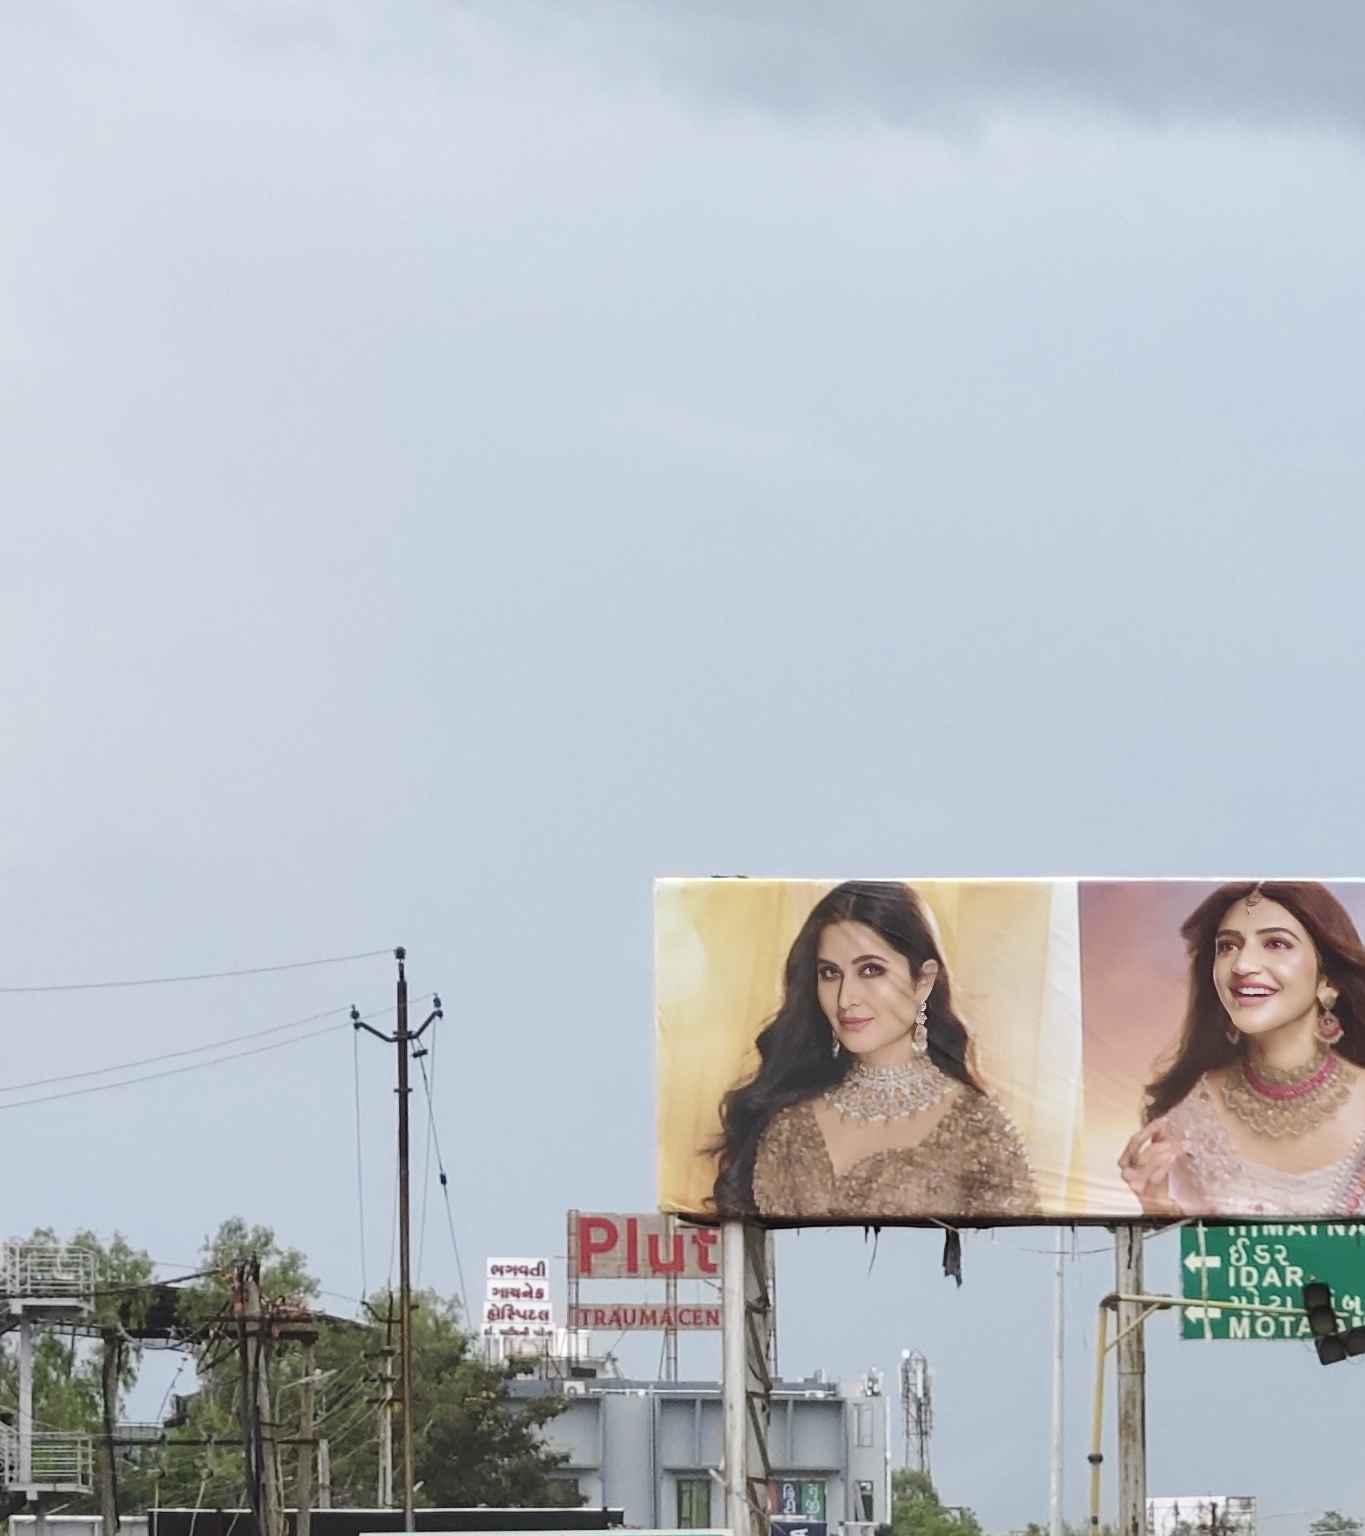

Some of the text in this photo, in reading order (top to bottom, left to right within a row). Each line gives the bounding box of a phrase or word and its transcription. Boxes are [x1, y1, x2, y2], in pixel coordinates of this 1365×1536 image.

[1229, 1238, 1290, 1266] ઈડર
[490, 1260, 546, 1277] ભગવતી
[1228, 1266, 1304, 1287] IDAR
[582, 1308, 673, 1327] TRAUMA
[1229, 1316, 1311, 1338] MOTA
